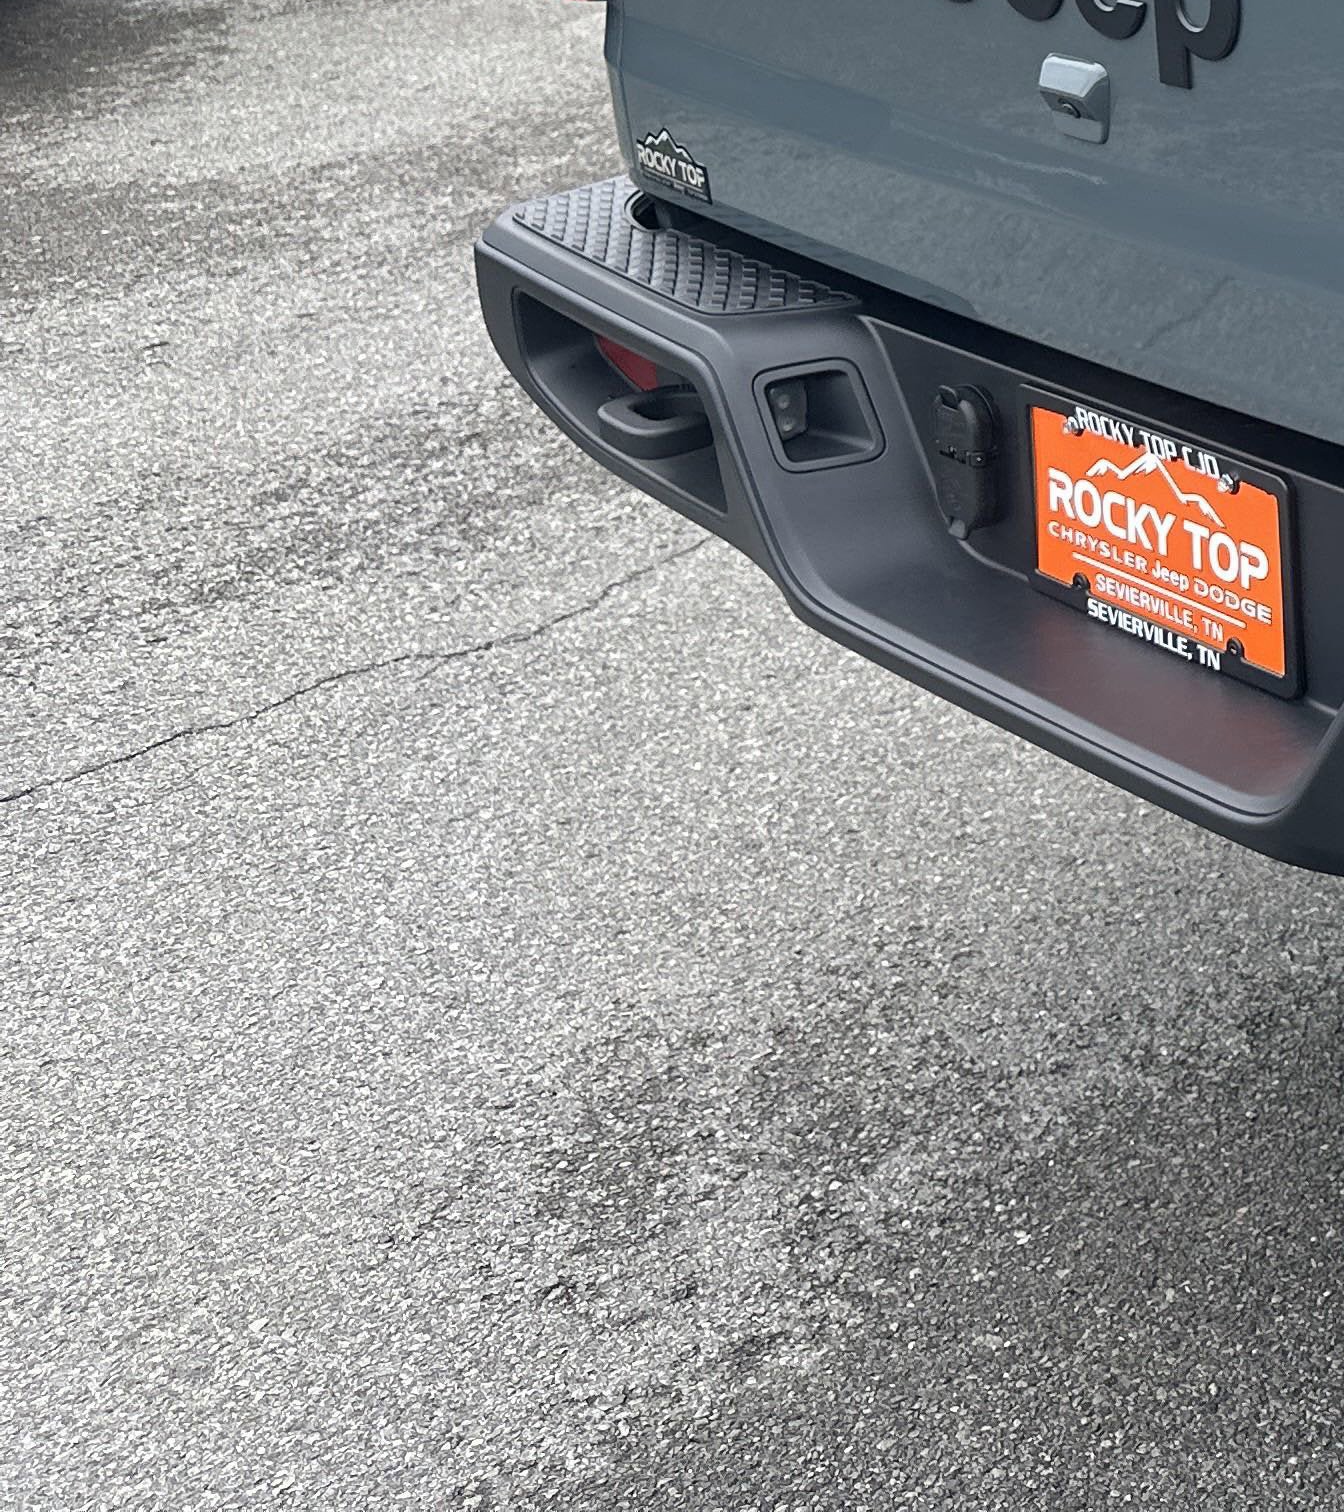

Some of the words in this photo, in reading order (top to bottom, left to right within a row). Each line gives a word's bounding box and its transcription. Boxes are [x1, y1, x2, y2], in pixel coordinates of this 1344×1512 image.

[636, 143, 677, 178] ROCKY
[1074, 406, 1134, 448] ROCKY
[1139, 430, 1178, 460] TOP
[1047, 467, 1177, 556] ROCKY
[1183, 519, 1270, 590] TOP
[1047, 520, 1149, 575] CHRYSLER
[1151, 560, 1190, 592] Jeep
[1193, 576, 1273, 625] DODGE
[1095, 573, 1199, 634] SEVIERVILLE,
[1201, 616, 1224, 642] TN
[1087, 597, 1193, 660] SEVIERVILLE,
[1195, 642, 1221, 671] TN
